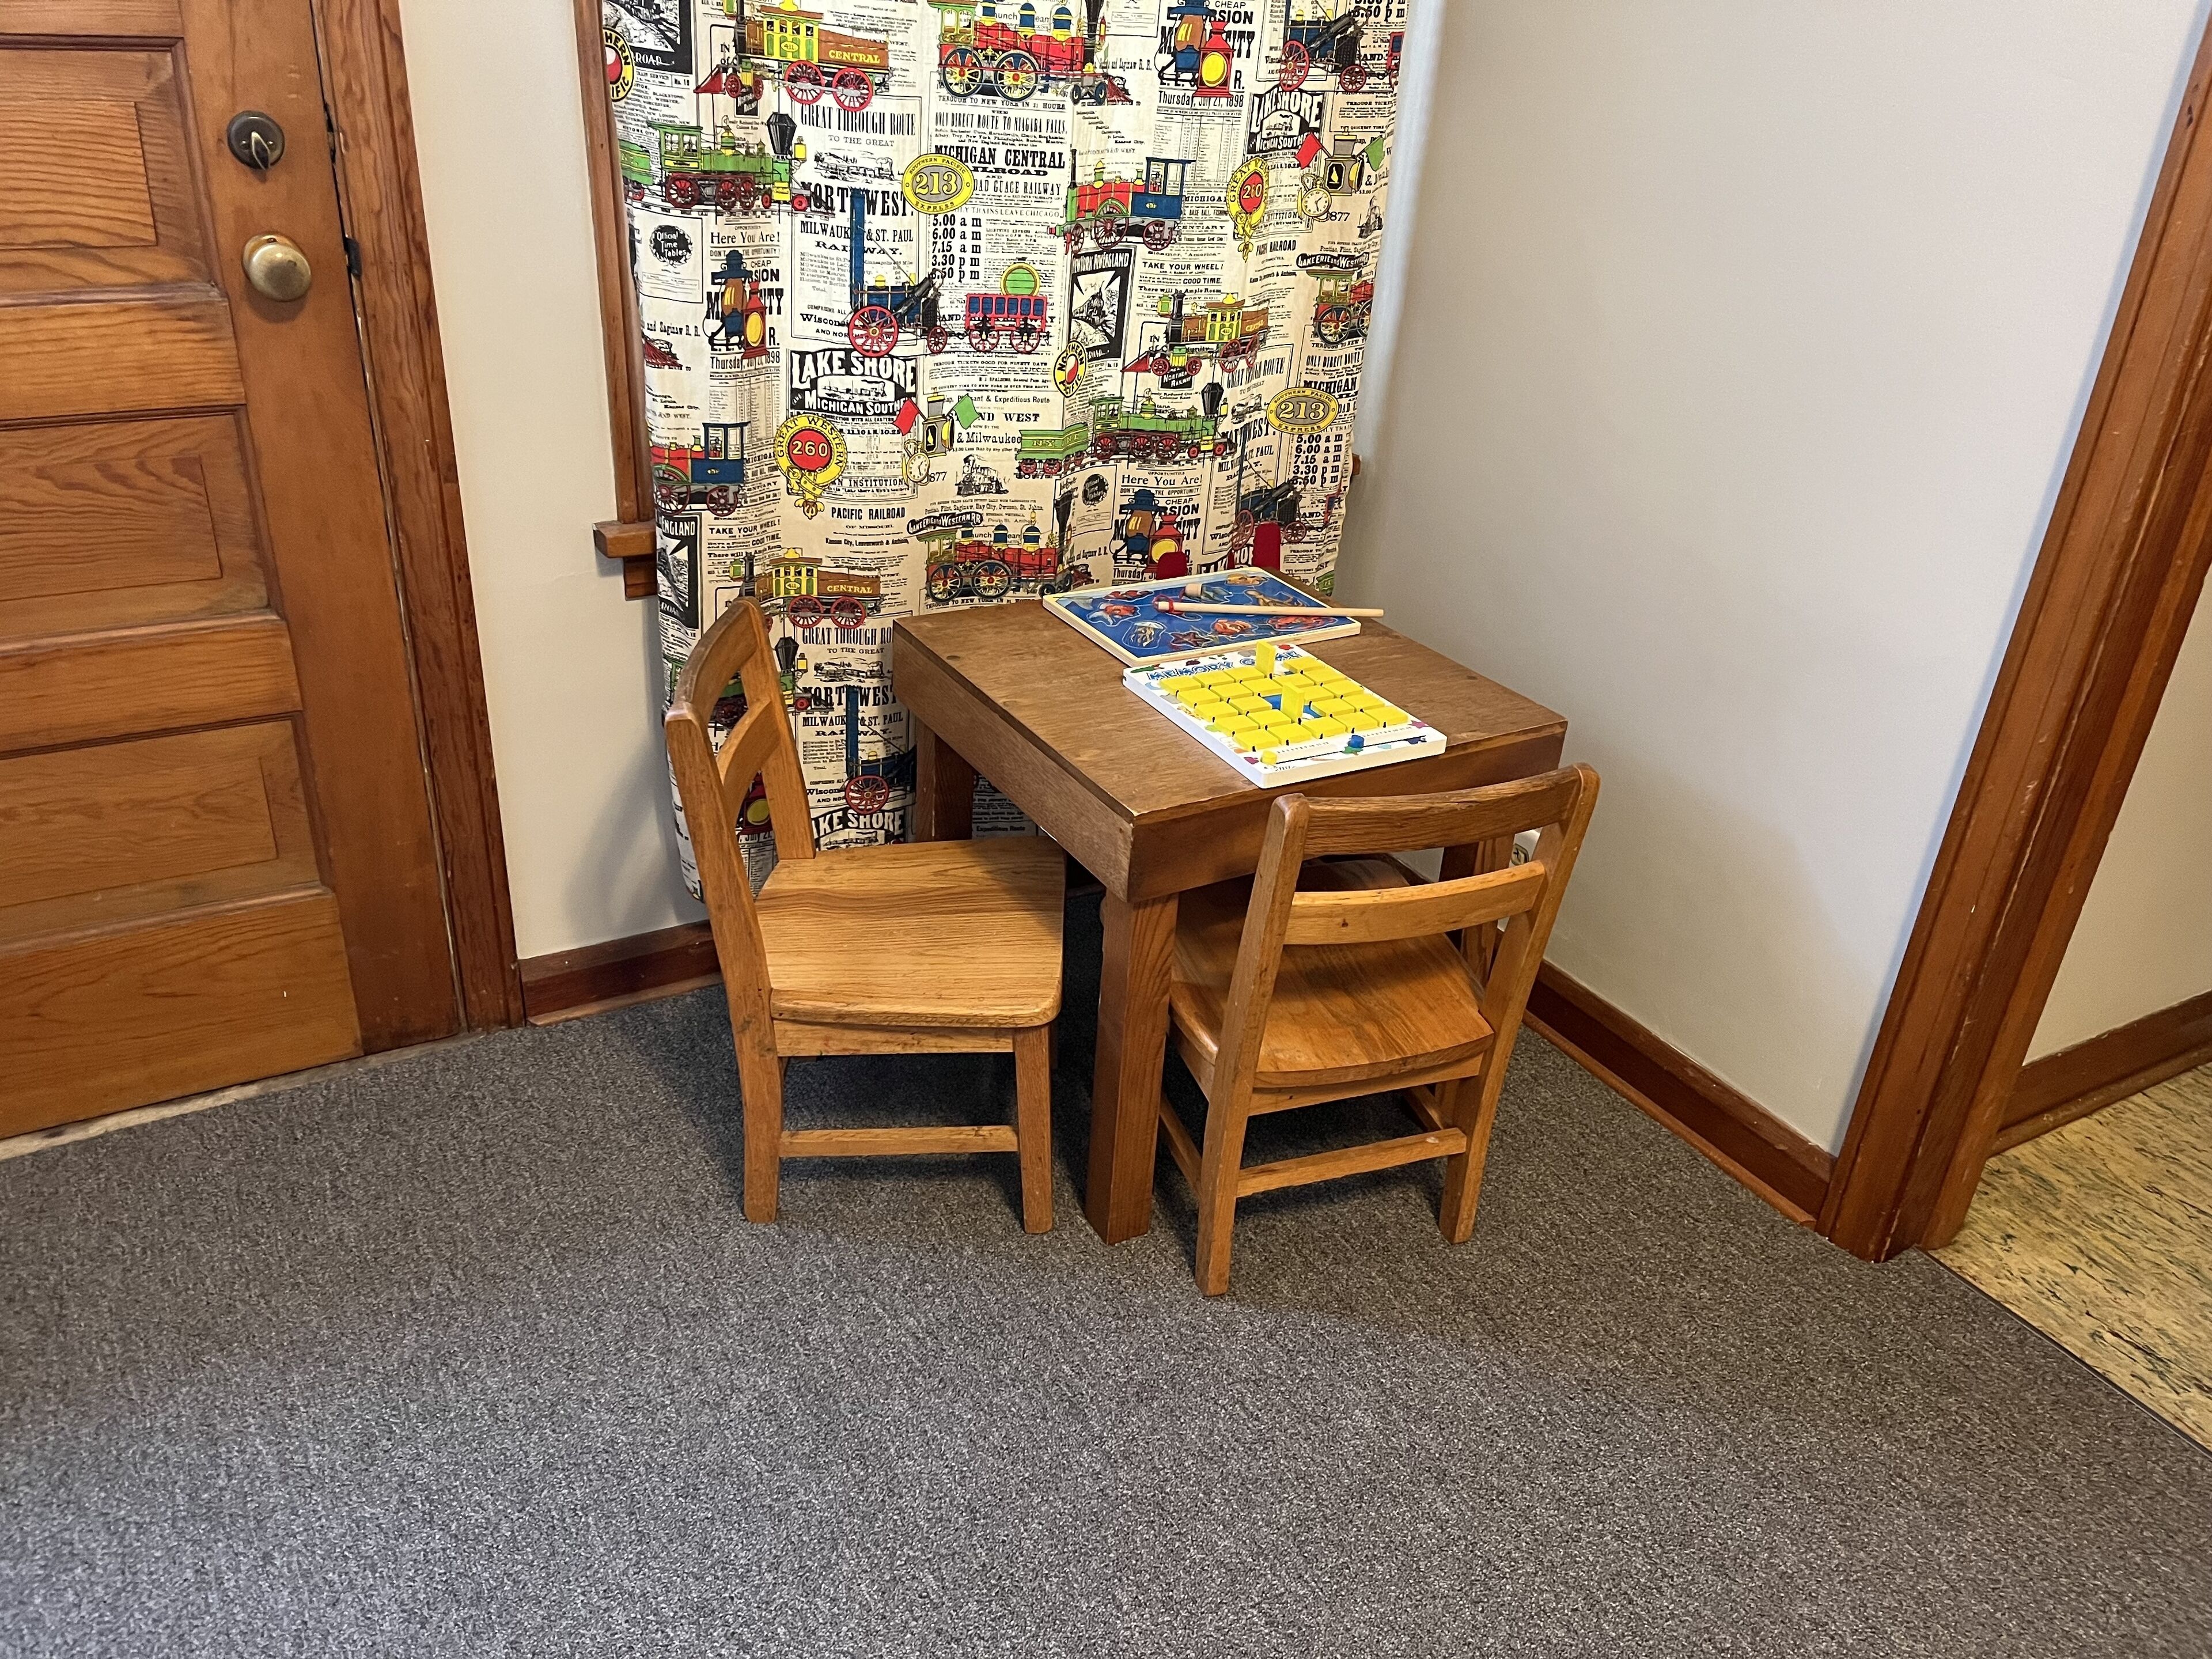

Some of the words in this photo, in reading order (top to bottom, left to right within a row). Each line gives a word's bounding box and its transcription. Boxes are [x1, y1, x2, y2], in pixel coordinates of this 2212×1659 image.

[829, 50, 880, 64] CENTRAL
[801, 105, 833, 129] GREAT
[836, 108, 885, 134] THROUGH
[890, 113, 916, 135] ROUTE
[951, 113, 974, 128] DIRECT
[978, 114, 999, 130] ROUTE
[1003, 116, 1012, 130] TO
[1014, 116, 1042, 133] NIAGARA
[908, 157, 938, 174] SOUTHERN
[1005, 149, 1065, 169] CENTRAL
[942, 158, 966, 175] PACIFIC
[915, 172, 958, 195] 213
[1024, 181, 1061, 196] RAILWAY
[914, 201, 955, 211] EXPRESS
[932, 214, 956, 226] 5.00
[960, 217, 967, 226] a
[972, 217, 982, 227] m
[656, 232, 678, 241] Official
[800, 220, 851, 239] MILWAUK
[866, 228, 873, 241] &
[876, 229, 889, 242] ST.
[893, 229, 914, 242] PAUL
[932, 228, 956, 240] 6.00
[960, 230, 967, 240] a
[971, 230, 982, 240] m
[711, 232, 736, 244] Here
[740, 232, 755, 243] You
[661, 240, 677, 253] Time
[664, 247, 687, 257] Tables
[815, 241, 902, 255] RAIWAY.
[932, 241, 952, 253] 7.15
[960, 244, 967, 253] a
[971, 244, 981, 253] m
[1270, 240, 1296, 252] RAILROAD
[931, 254, 955, 266] 3.30
[959, 257, 965, 270] p
[970, 257, 980, 267] m
[959, 270, 965, 282] p
[969, 270, 980, 279] m
[791, 351, 846, 389] LAKE
[851, 351, 916, 393] SHORE
[1164, 371, 1187, 383] NORTHER
[804, 389, 863, 414] MICHIGAN
[995, 395, 1031, 403] Expeditious
[1274, 390, 1306, 404] SOUTHERN
[1310, 391, 1333, 403] PACIFIC
[1003, 413, 1040, 422] WEST
[1280, 402, 1324, 420] 213
[777, 419, 798, 457] GREAT
[806, 416, 843, 468] WESTERN
[957, 433, 964, 443] &
[1296, 434, 1321, 444] 5.00
[1325, 434, 1331, 443] a
[791, 440, 828, 456] 260
[1255, 445, 1274, 457] PAUL
[1295, 445, 1321, 454] 6.00
[1324, 445, 1330, 453] a
[1323, 455, 1330, 463] a
[1332, 454, 1341, 463] m
[930, 472, 947, 482] 877
[1293, 465, 1319, 475] 3.30
[1321, 467, 1328, 477] p
[1331, 465, 1339, 473] m
[1122, 475, 1149, 484] Here
[1155, 476, 1176, 486] You
[831, 507, 862, 520] PACIFIC
[869, 507, 906, 520] RAILROAD
[737, 525, 757, 533] YOUR
[827, 585, 873, 594] CENTRAL
[802, 627, 832, 645] GREAT
[834, 627, 877, 646] THROUGH
[1147, 661, 1234, 681] MEMORY
[1239, 650, 1303, 666] GME
[802, 717, 846, 727] MILWAUK
[859, 717, 866, 726] &
[868, 716, 880, 726] ST.
[882, 712, 903, 725] PAUL
[848, 809, 906, 835] SHORE
